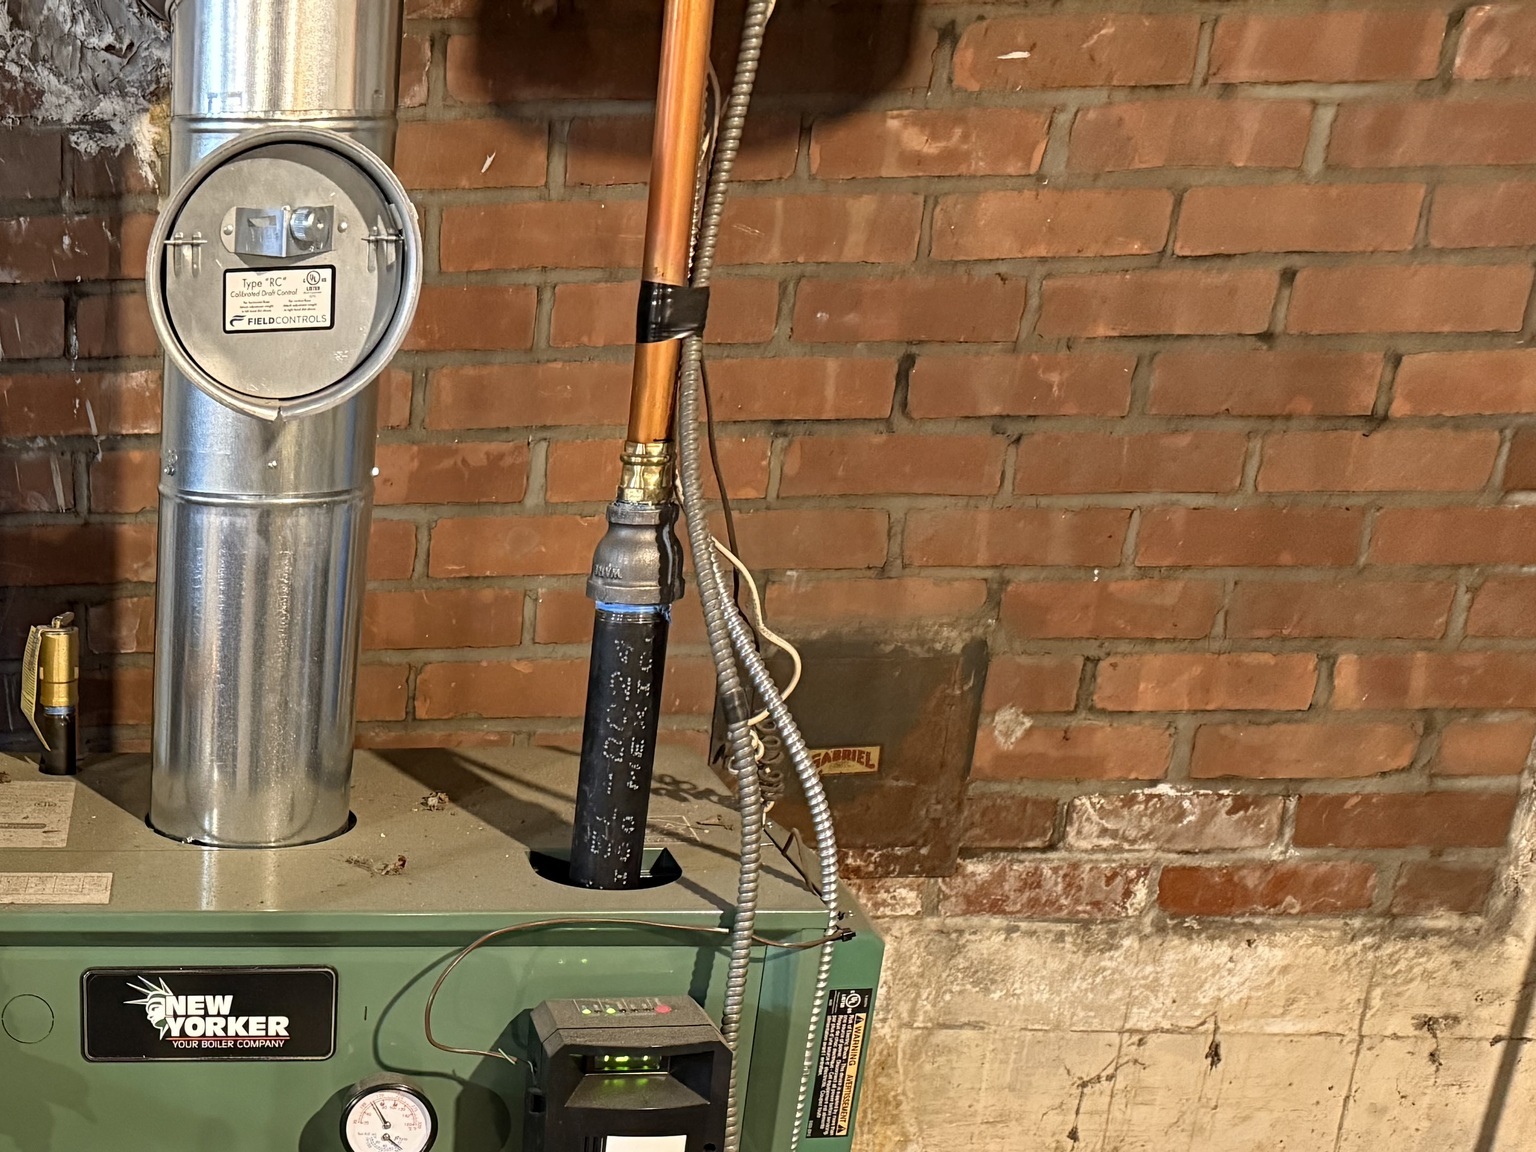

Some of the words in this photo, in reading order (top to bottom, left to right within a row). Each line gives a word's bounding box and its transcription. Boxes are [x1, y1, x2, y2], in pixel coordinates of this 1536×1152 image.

[230, 290, 260, 298] Calibrated
[242, 279, 262, 290] Type
[812, 749, 875, 769] GABRIEL
[165, 995, 233, 1016] NEW
[165, 1016, 290, 1037] YORKER
[172, 1040, 199, 1049] YOUR
[201, 1040, 234, 1048] BOILER
[237, 1040, 285, 1048] COMPANY
[848, 1025, 862, 1066] WARNING
[839, 1074, 853, 1122] AVERTISSEMENT
